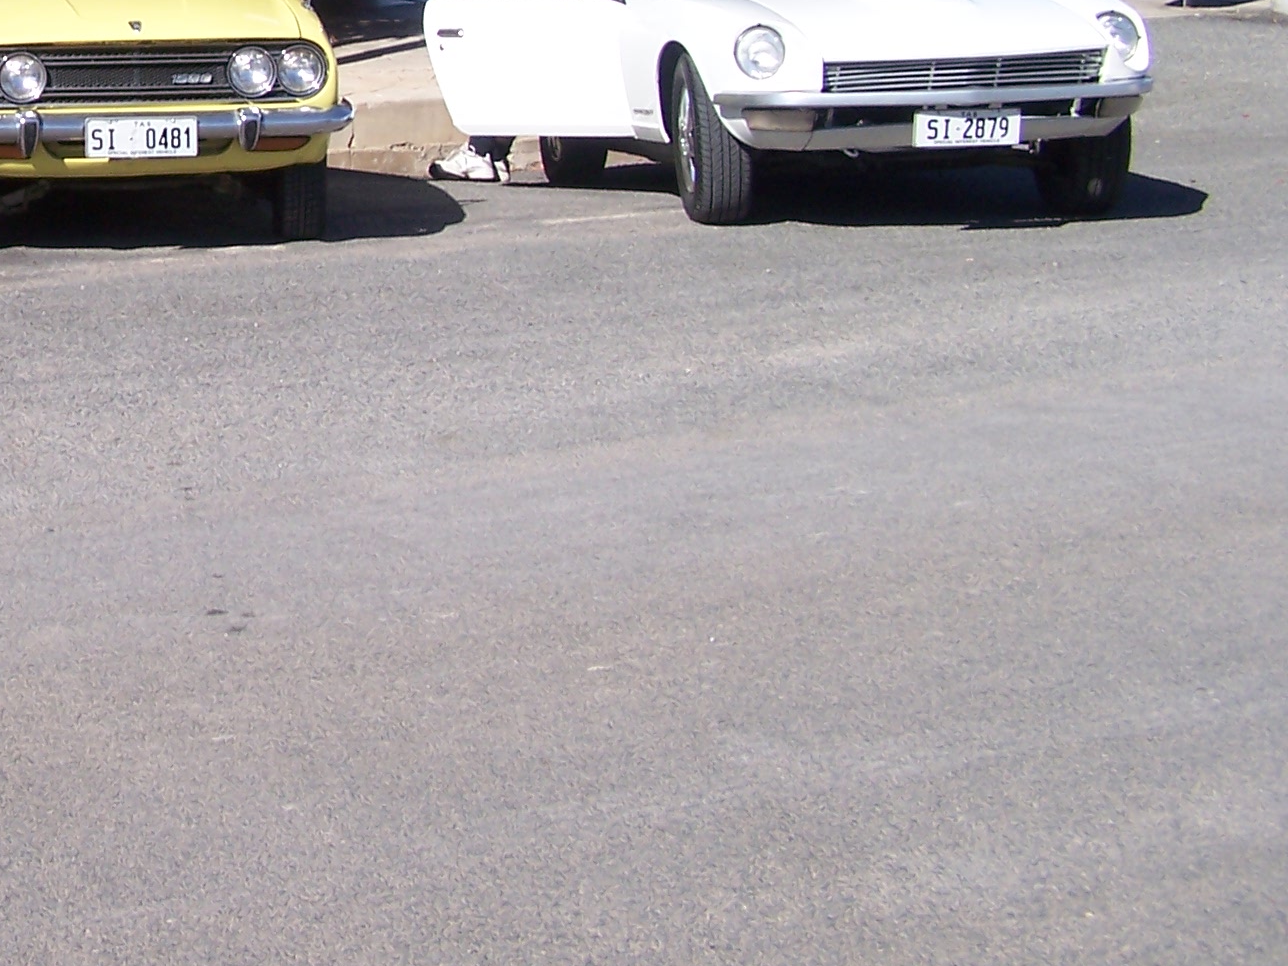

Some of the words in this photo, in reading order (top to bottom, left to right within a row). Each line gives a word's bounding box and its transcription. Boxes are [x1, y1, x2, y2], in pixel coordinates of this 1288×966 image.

[92, 129, 114, 150] SI
[146, 127, 190, 149] 0481
[927, 119, 950, 139] SI
[963, 117, 1009, 138] 2879
